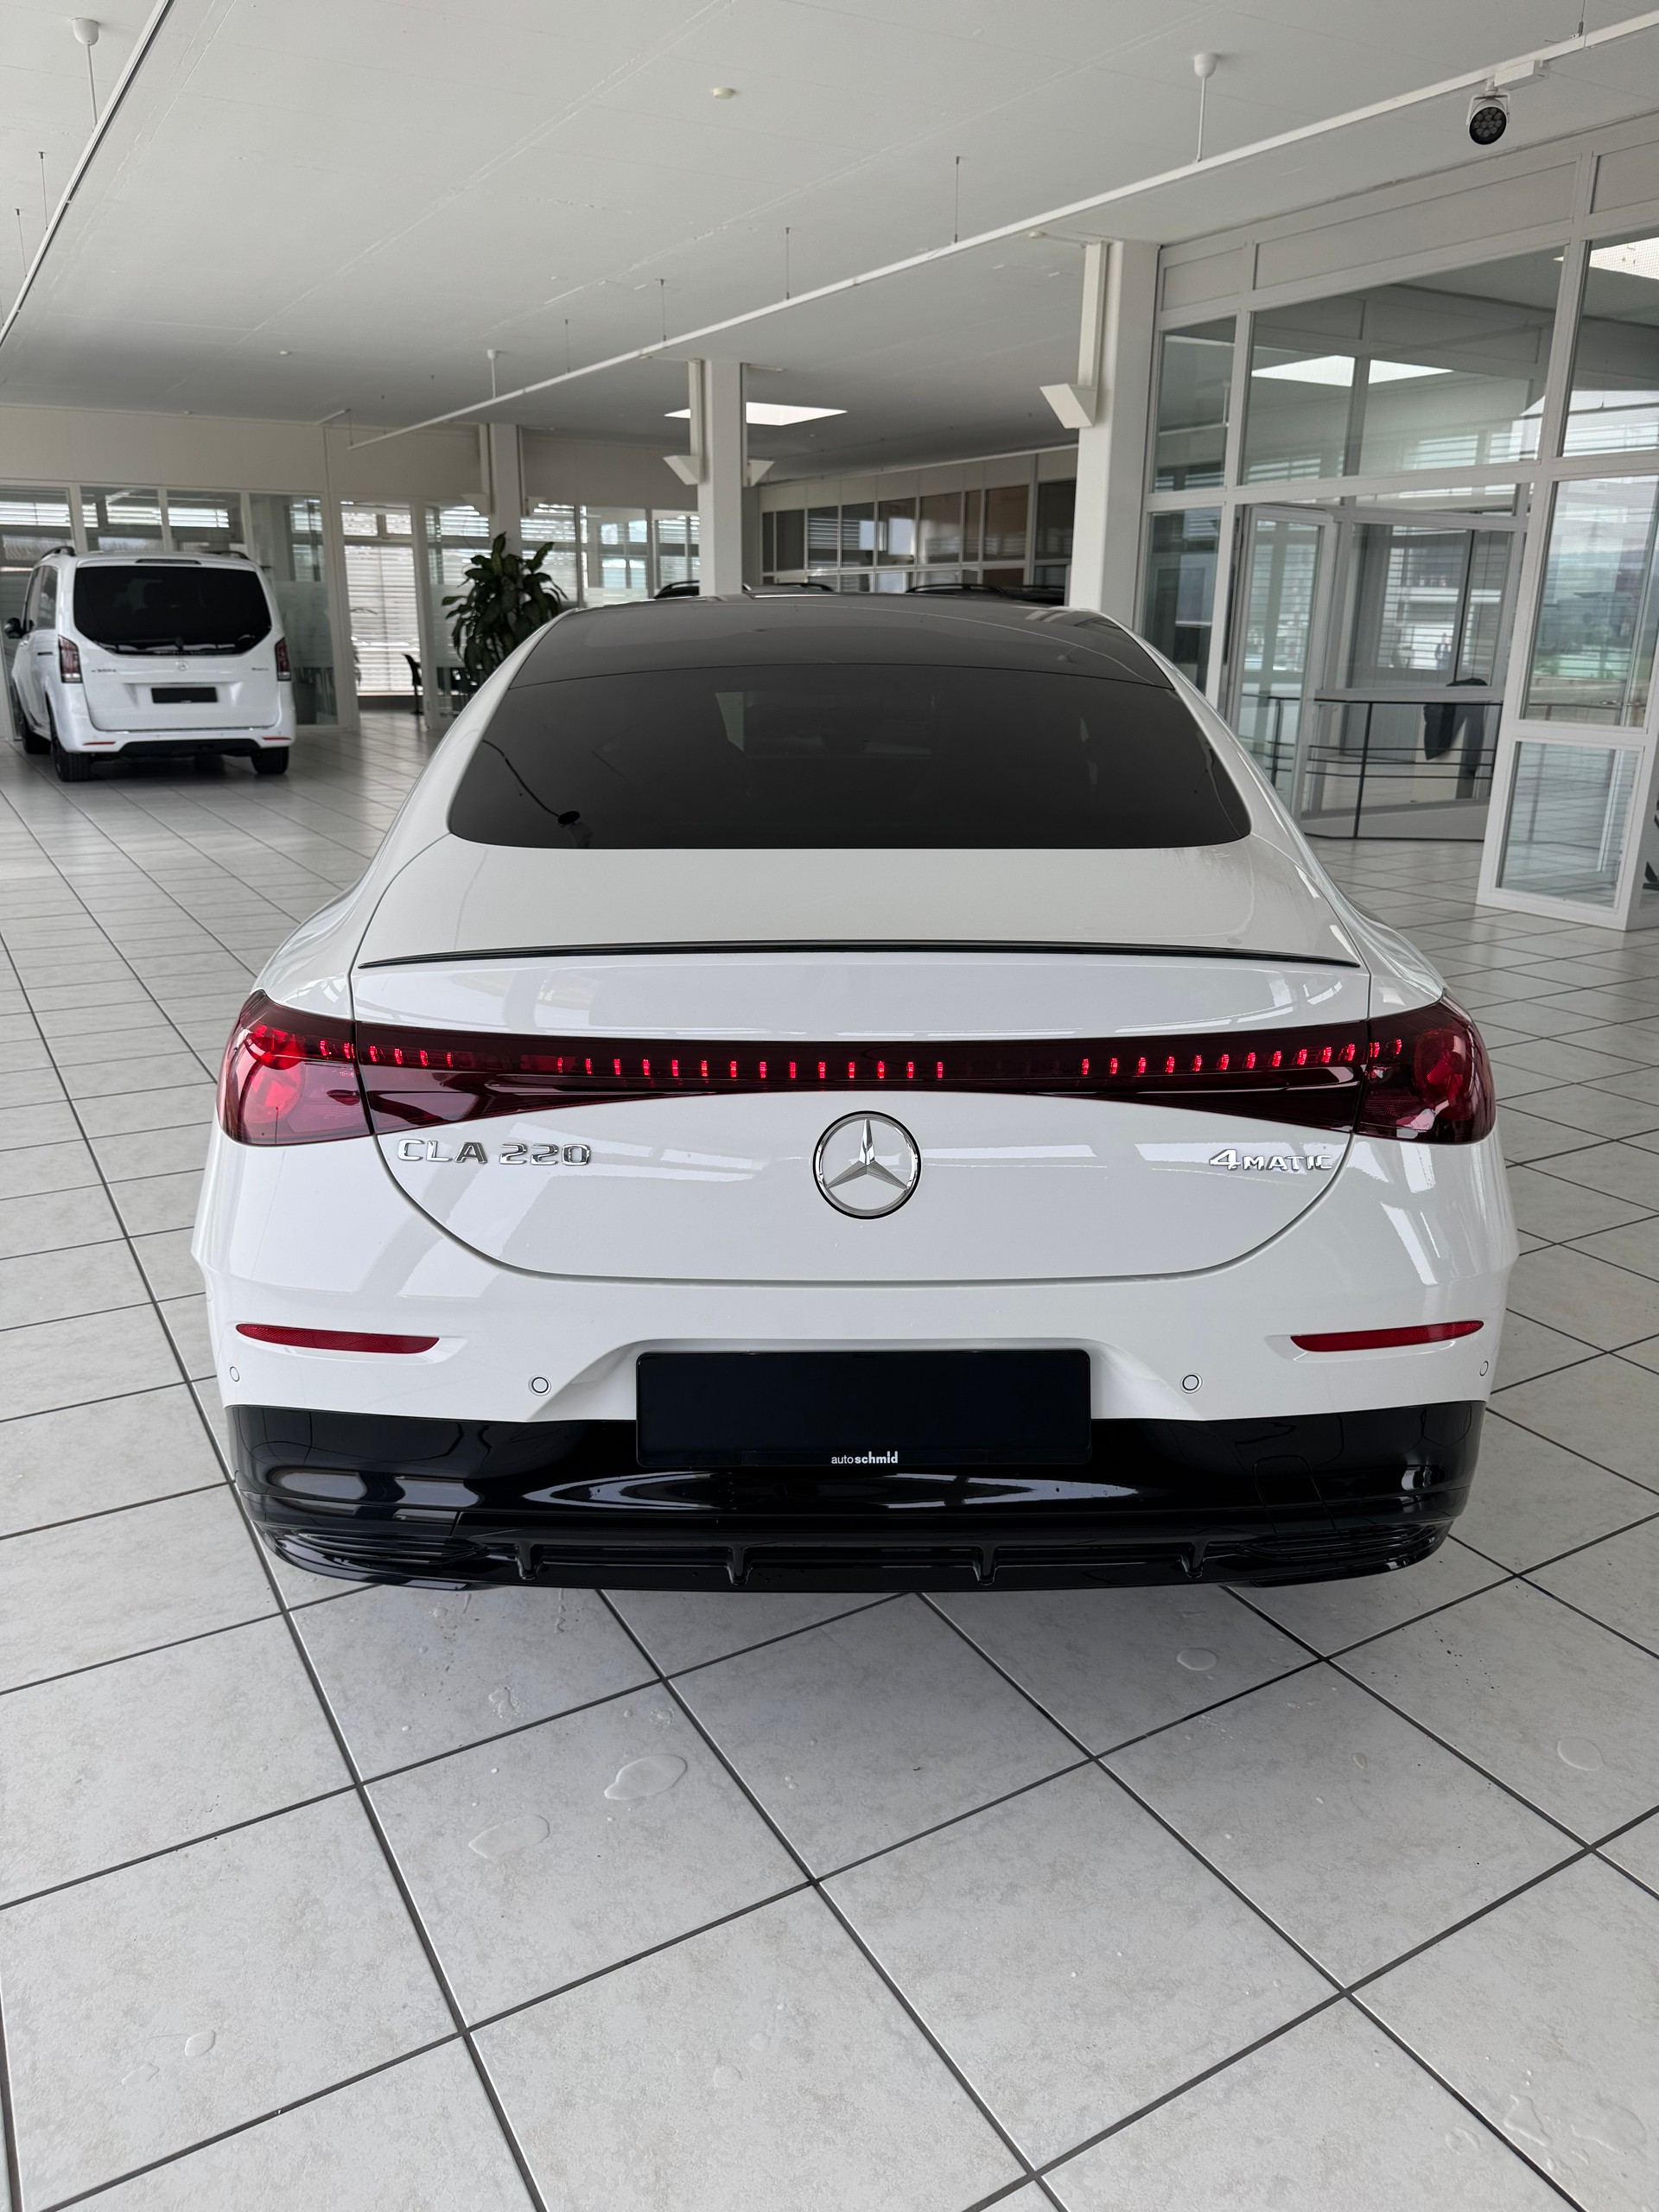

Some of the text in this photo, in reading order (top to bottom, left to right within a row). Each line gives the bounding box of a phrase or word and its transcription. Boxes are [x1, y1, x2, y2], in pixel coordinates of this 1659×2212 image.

[397, 1139, 591, 1166] CLA 220
[1210, 1149, 1332, 1171] 4MATIC
[831, 1451, 899, 1464] autoschmid
